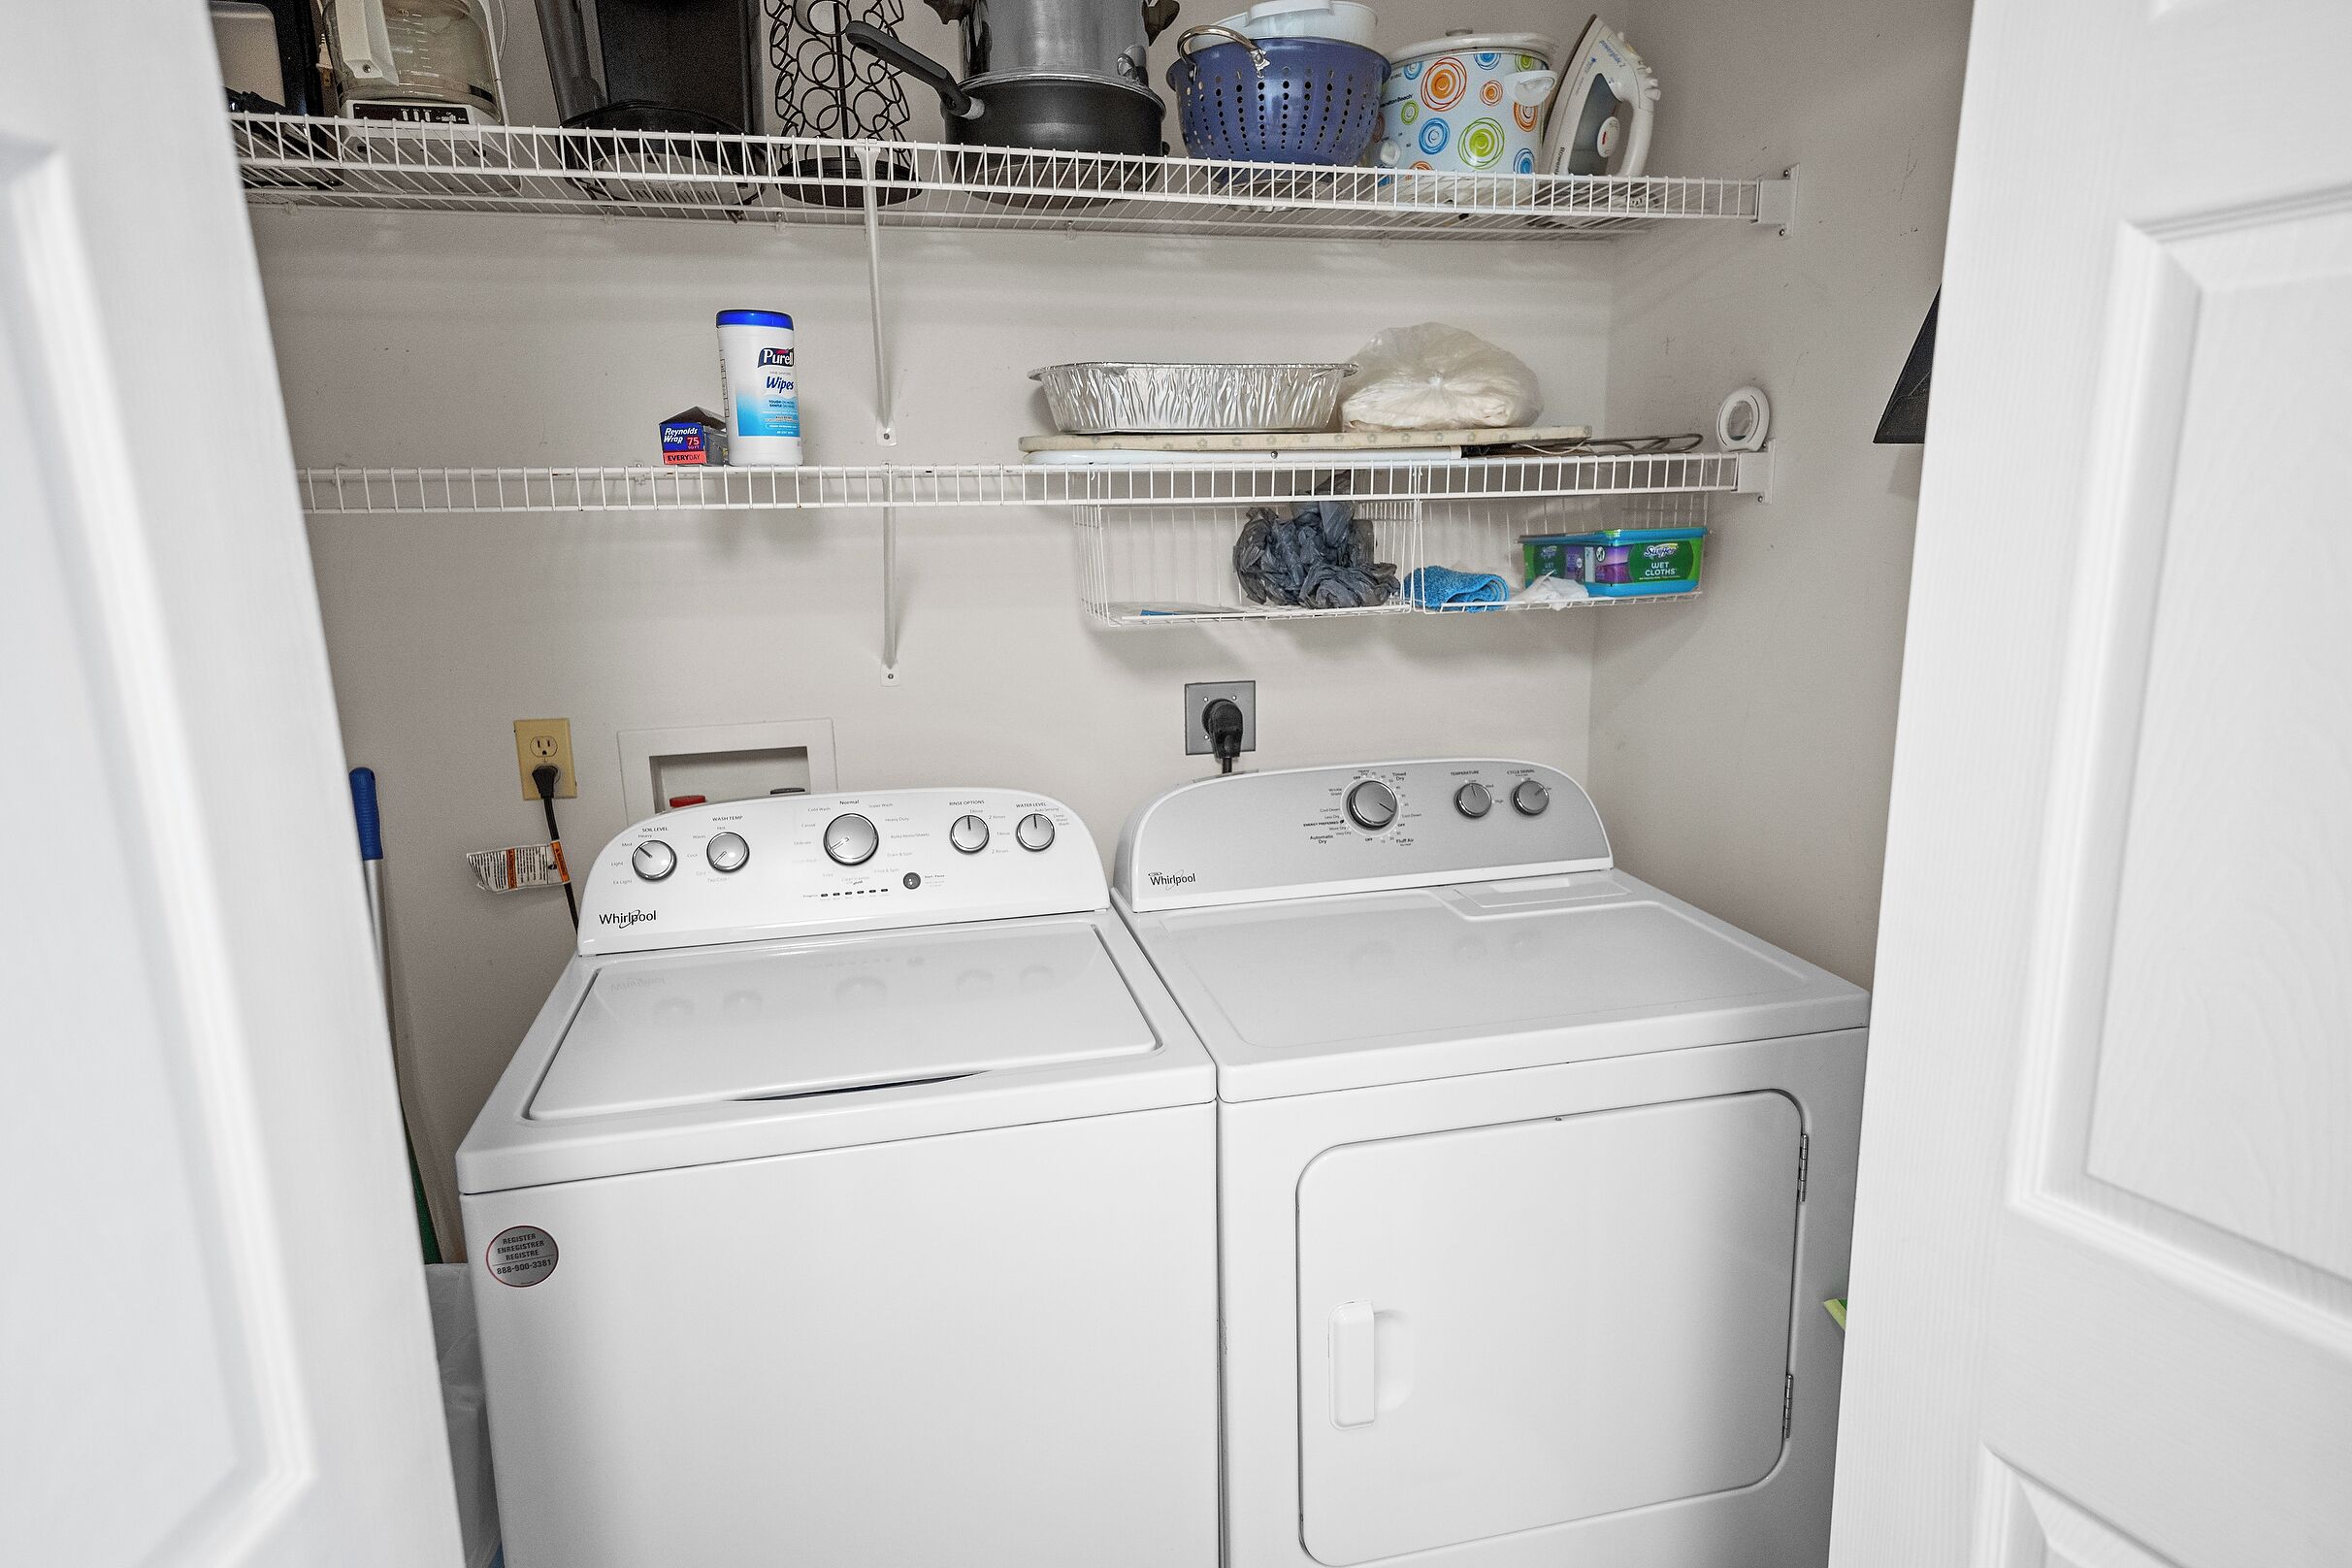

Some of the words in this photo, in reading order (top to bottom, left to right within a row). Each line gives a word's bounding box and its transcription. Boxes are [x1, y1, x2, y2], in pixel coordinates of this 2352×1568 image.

[767, 376, 794, 394] Wipes
[665, 427, 698, 437] Reynolds
[664, 435, 683, 444] Wrap
[687, 437, 700, 445] 75
[1149, 871, 1195, 887] Whirlpool
[599, 910, 657, 929] Whirlpool
[503, 1232, 537, 1245] REGISTER
[497, 1240, 544, 1254] ENREGISTRER
[506, 1250, 539, 1261] REGISTRE
